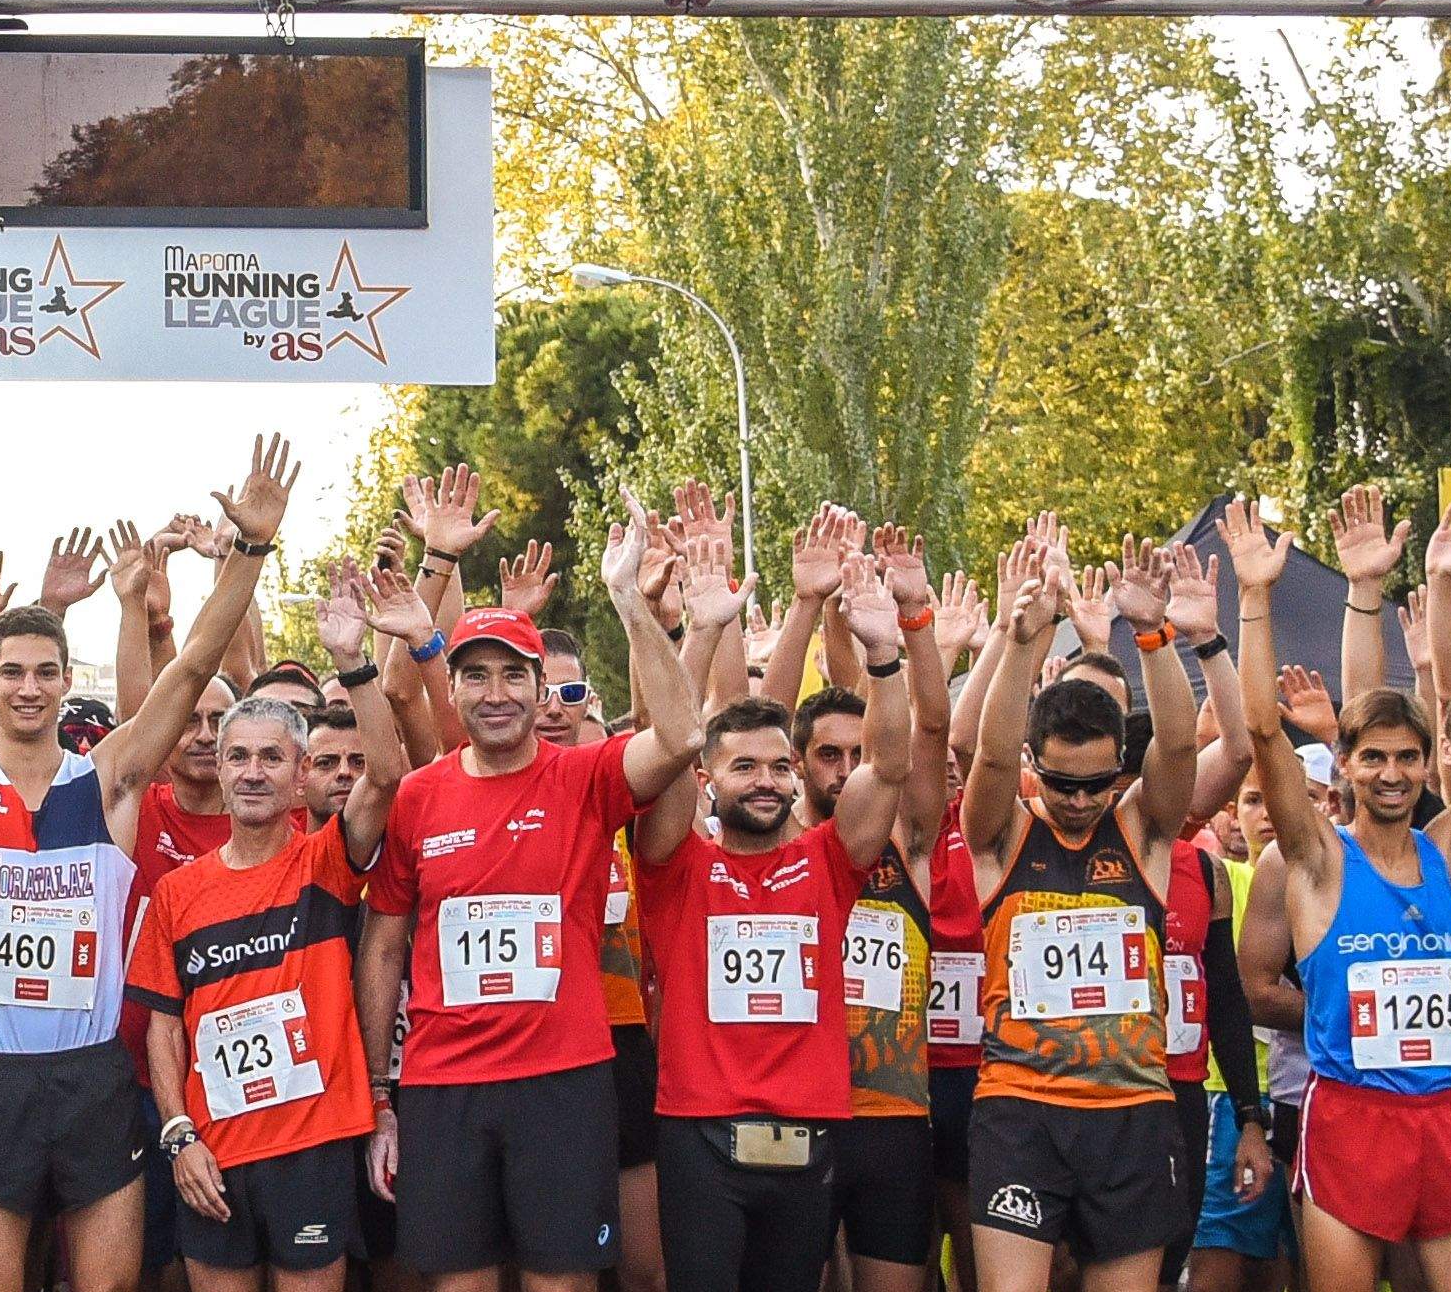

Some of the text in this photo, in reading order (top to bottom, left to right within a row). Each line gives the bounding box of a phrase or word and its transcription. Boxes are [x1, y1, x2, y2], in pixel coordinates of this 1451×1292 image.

[164, 273, 321, 298] RUNNING
[164, 299, 322, 329] LEAGUE
[243, 331, 324, 362] by as
[456, 928, 518, 966] 115
[541, 934, 553, 958] 10K
[1011, 931, 1023, 953] 914
[77, 943, 90, 968] 10K
[723, 948, 786, 985] 937
[804, 956, 814, 979] 10K
[1043, 940, 1110, 980] 914
[1129, 945, 1140, 970] 10K
[1358, 1002, 1371, 1027] 10K
[291, 1028, 307, 1054] 10K
[214, 1033, 274, 1079] 123
